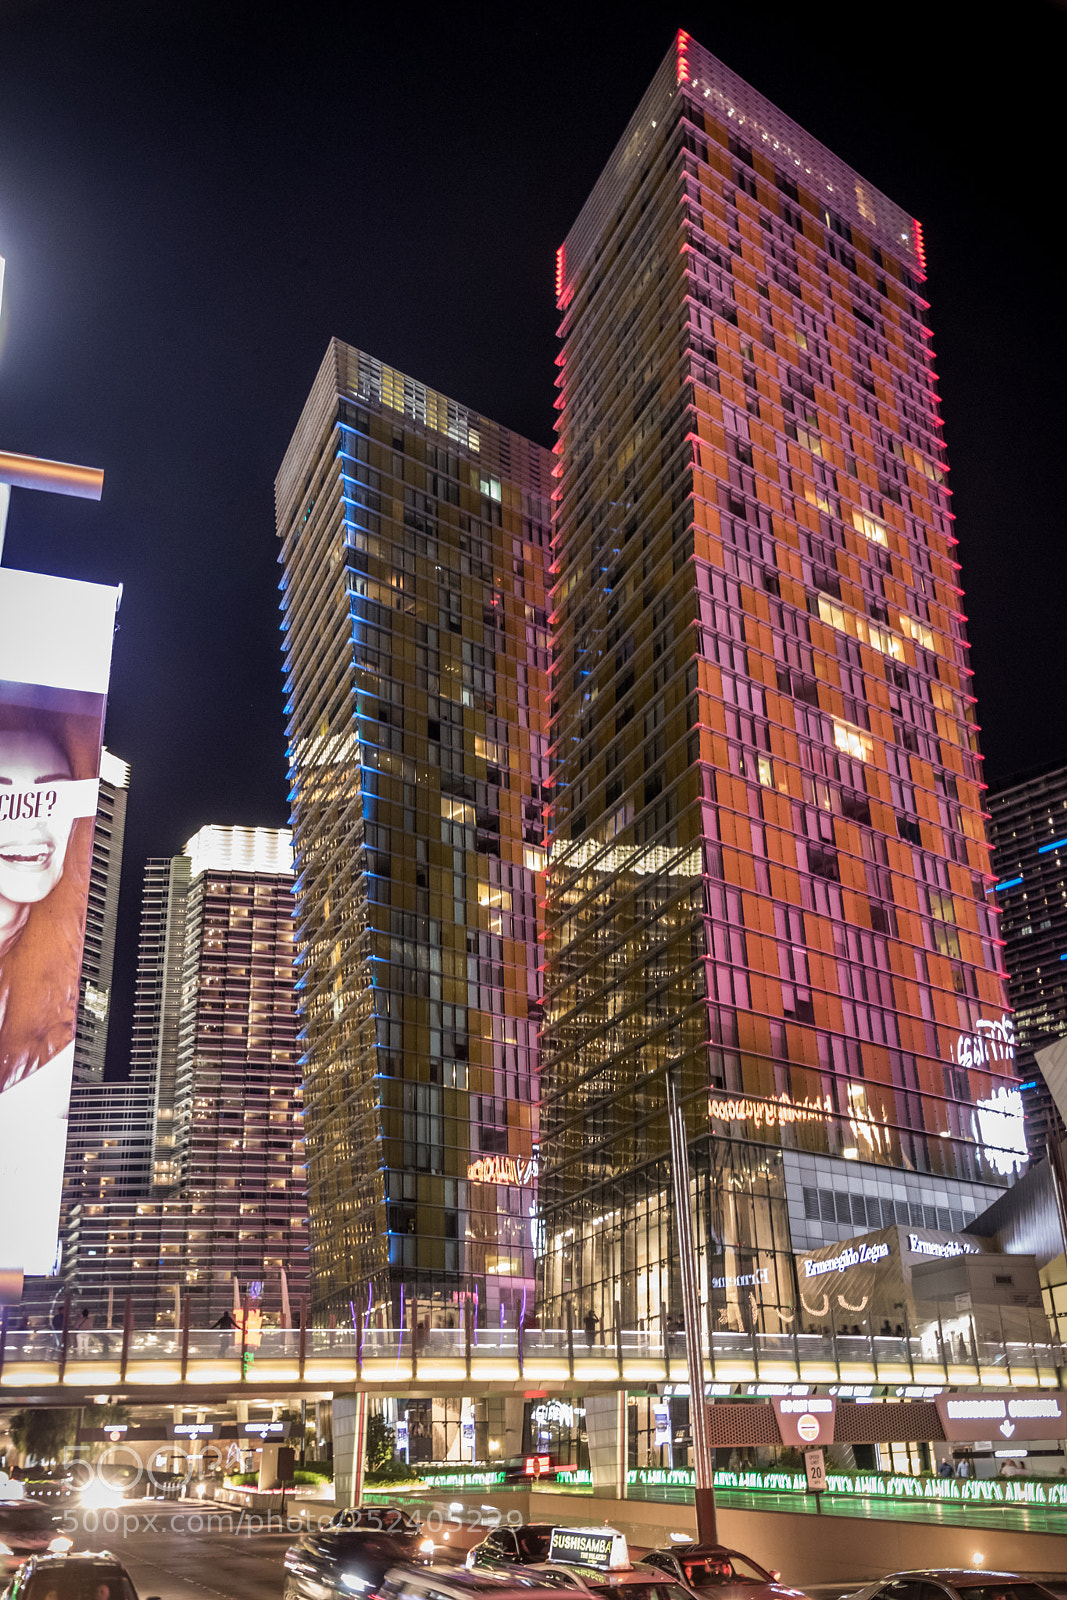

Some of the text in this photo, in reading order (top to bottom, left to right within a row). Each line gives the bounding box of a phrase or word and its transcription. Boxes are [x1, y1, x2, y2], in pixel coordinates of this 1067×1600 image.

[804, 1243, 889, 1278] Ermenegildo Zegna
[810, 1466, 822, 1479] 20
[552, 1534, 612, 1554] SUSHISAMBA
